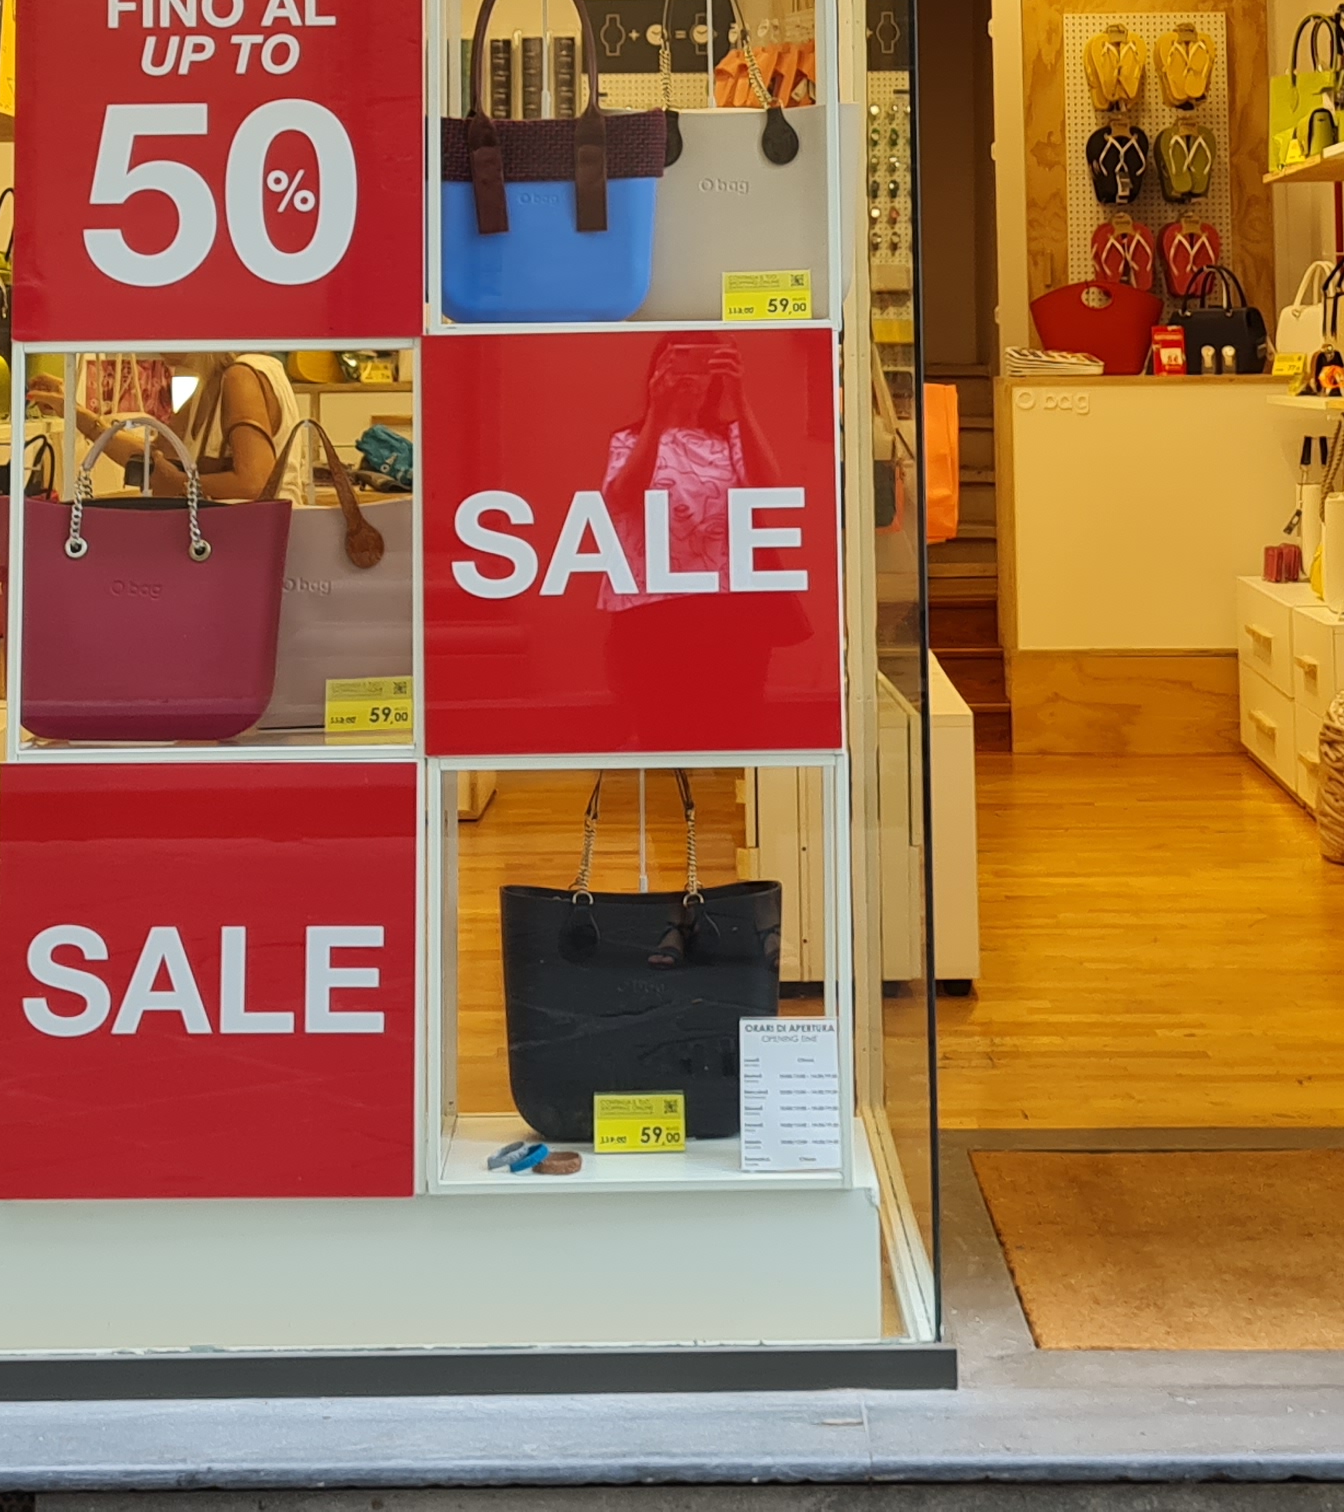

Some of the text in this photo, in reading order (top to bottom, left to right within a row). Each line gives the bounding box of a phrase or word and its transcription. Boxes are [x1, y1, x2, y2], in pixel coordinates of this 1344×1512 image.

[140, 32, 301, 77] UP TO
[716, 177, 750, 195] bag
[767, 297, 807, 316] 59,00
[1043, 389, 1091, 416] bag
[451, 486, 809, 599] SALE
[369, 706, 409, 725] 59,00
[22, 923, 385, 1038] SALE
[788, 1023, 836, 1033] APERTURA
[640, 1125, 681, 1146] 59,00
